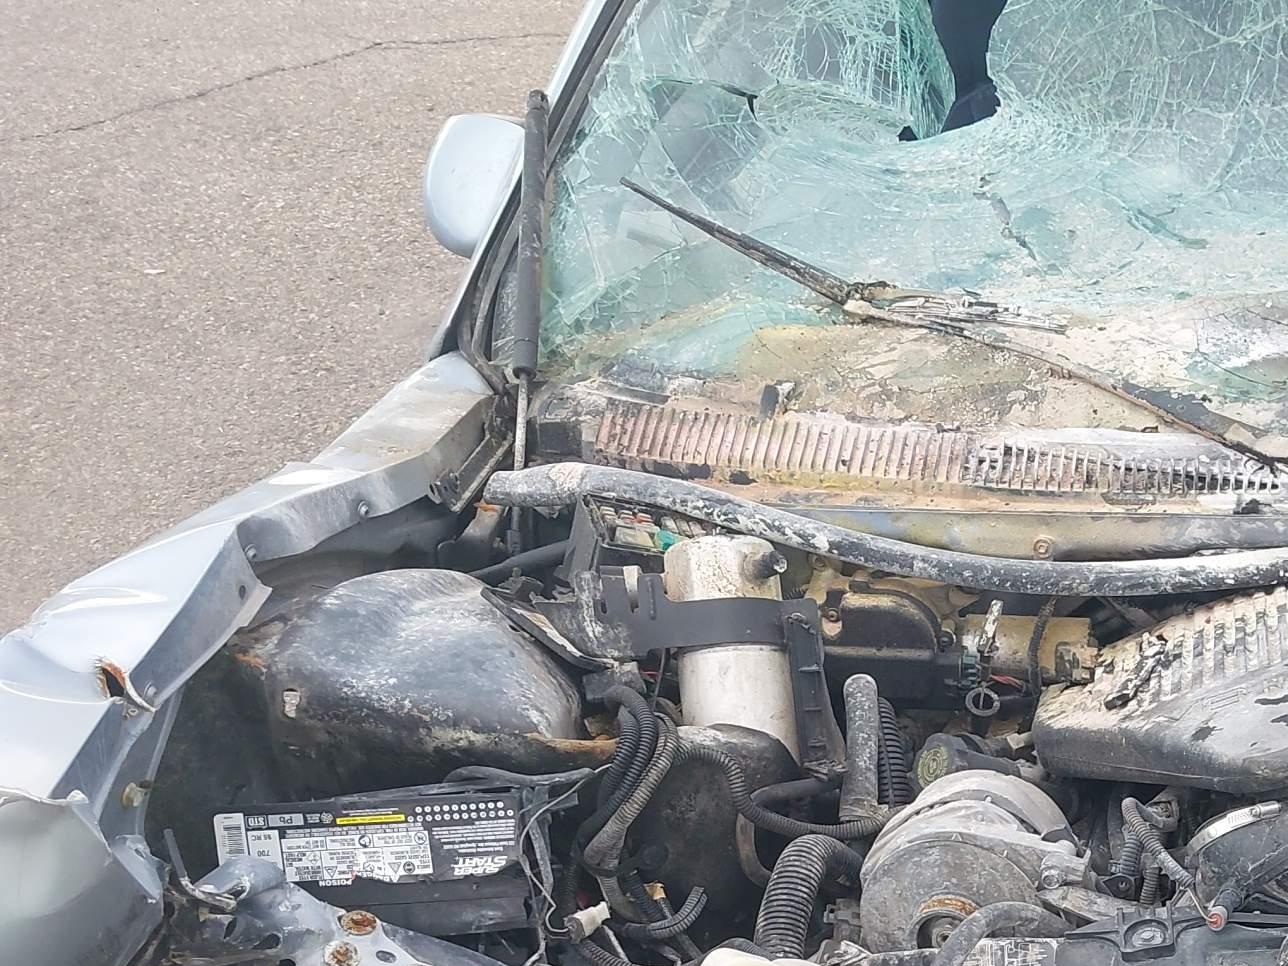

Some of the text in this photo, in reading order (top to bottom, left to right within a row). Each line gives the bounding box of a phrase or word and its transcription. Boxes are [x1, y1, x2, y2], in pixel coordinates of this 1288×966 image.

[279, 816, 293, 824] Pb
[453, 856, 508, 867] START
[454, 866, 499, 876] SUPER
